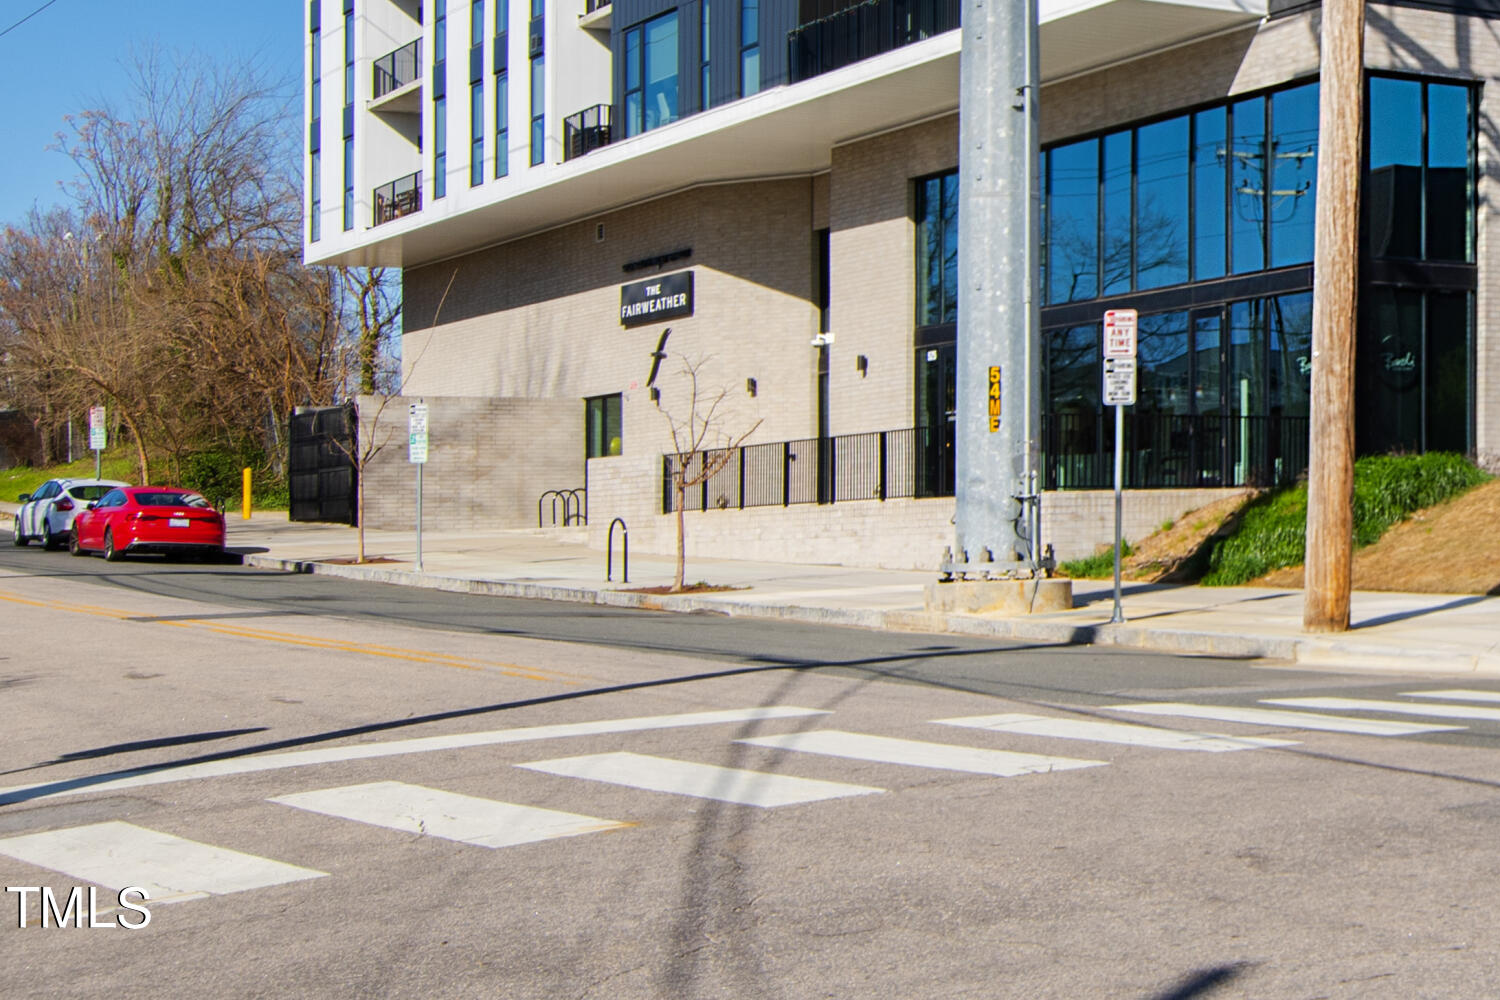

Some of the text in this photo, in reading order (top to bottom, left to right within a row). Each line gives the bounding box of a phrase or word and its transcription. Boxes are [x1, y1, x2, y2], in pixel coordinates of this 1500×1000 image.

[645, 284, 661, 296] THE
[621, 293, 686, 318] FAIRWEATHER
[1111, 328, 1129, 336] ANY
[1110, 338, 1130, 347] TIME
